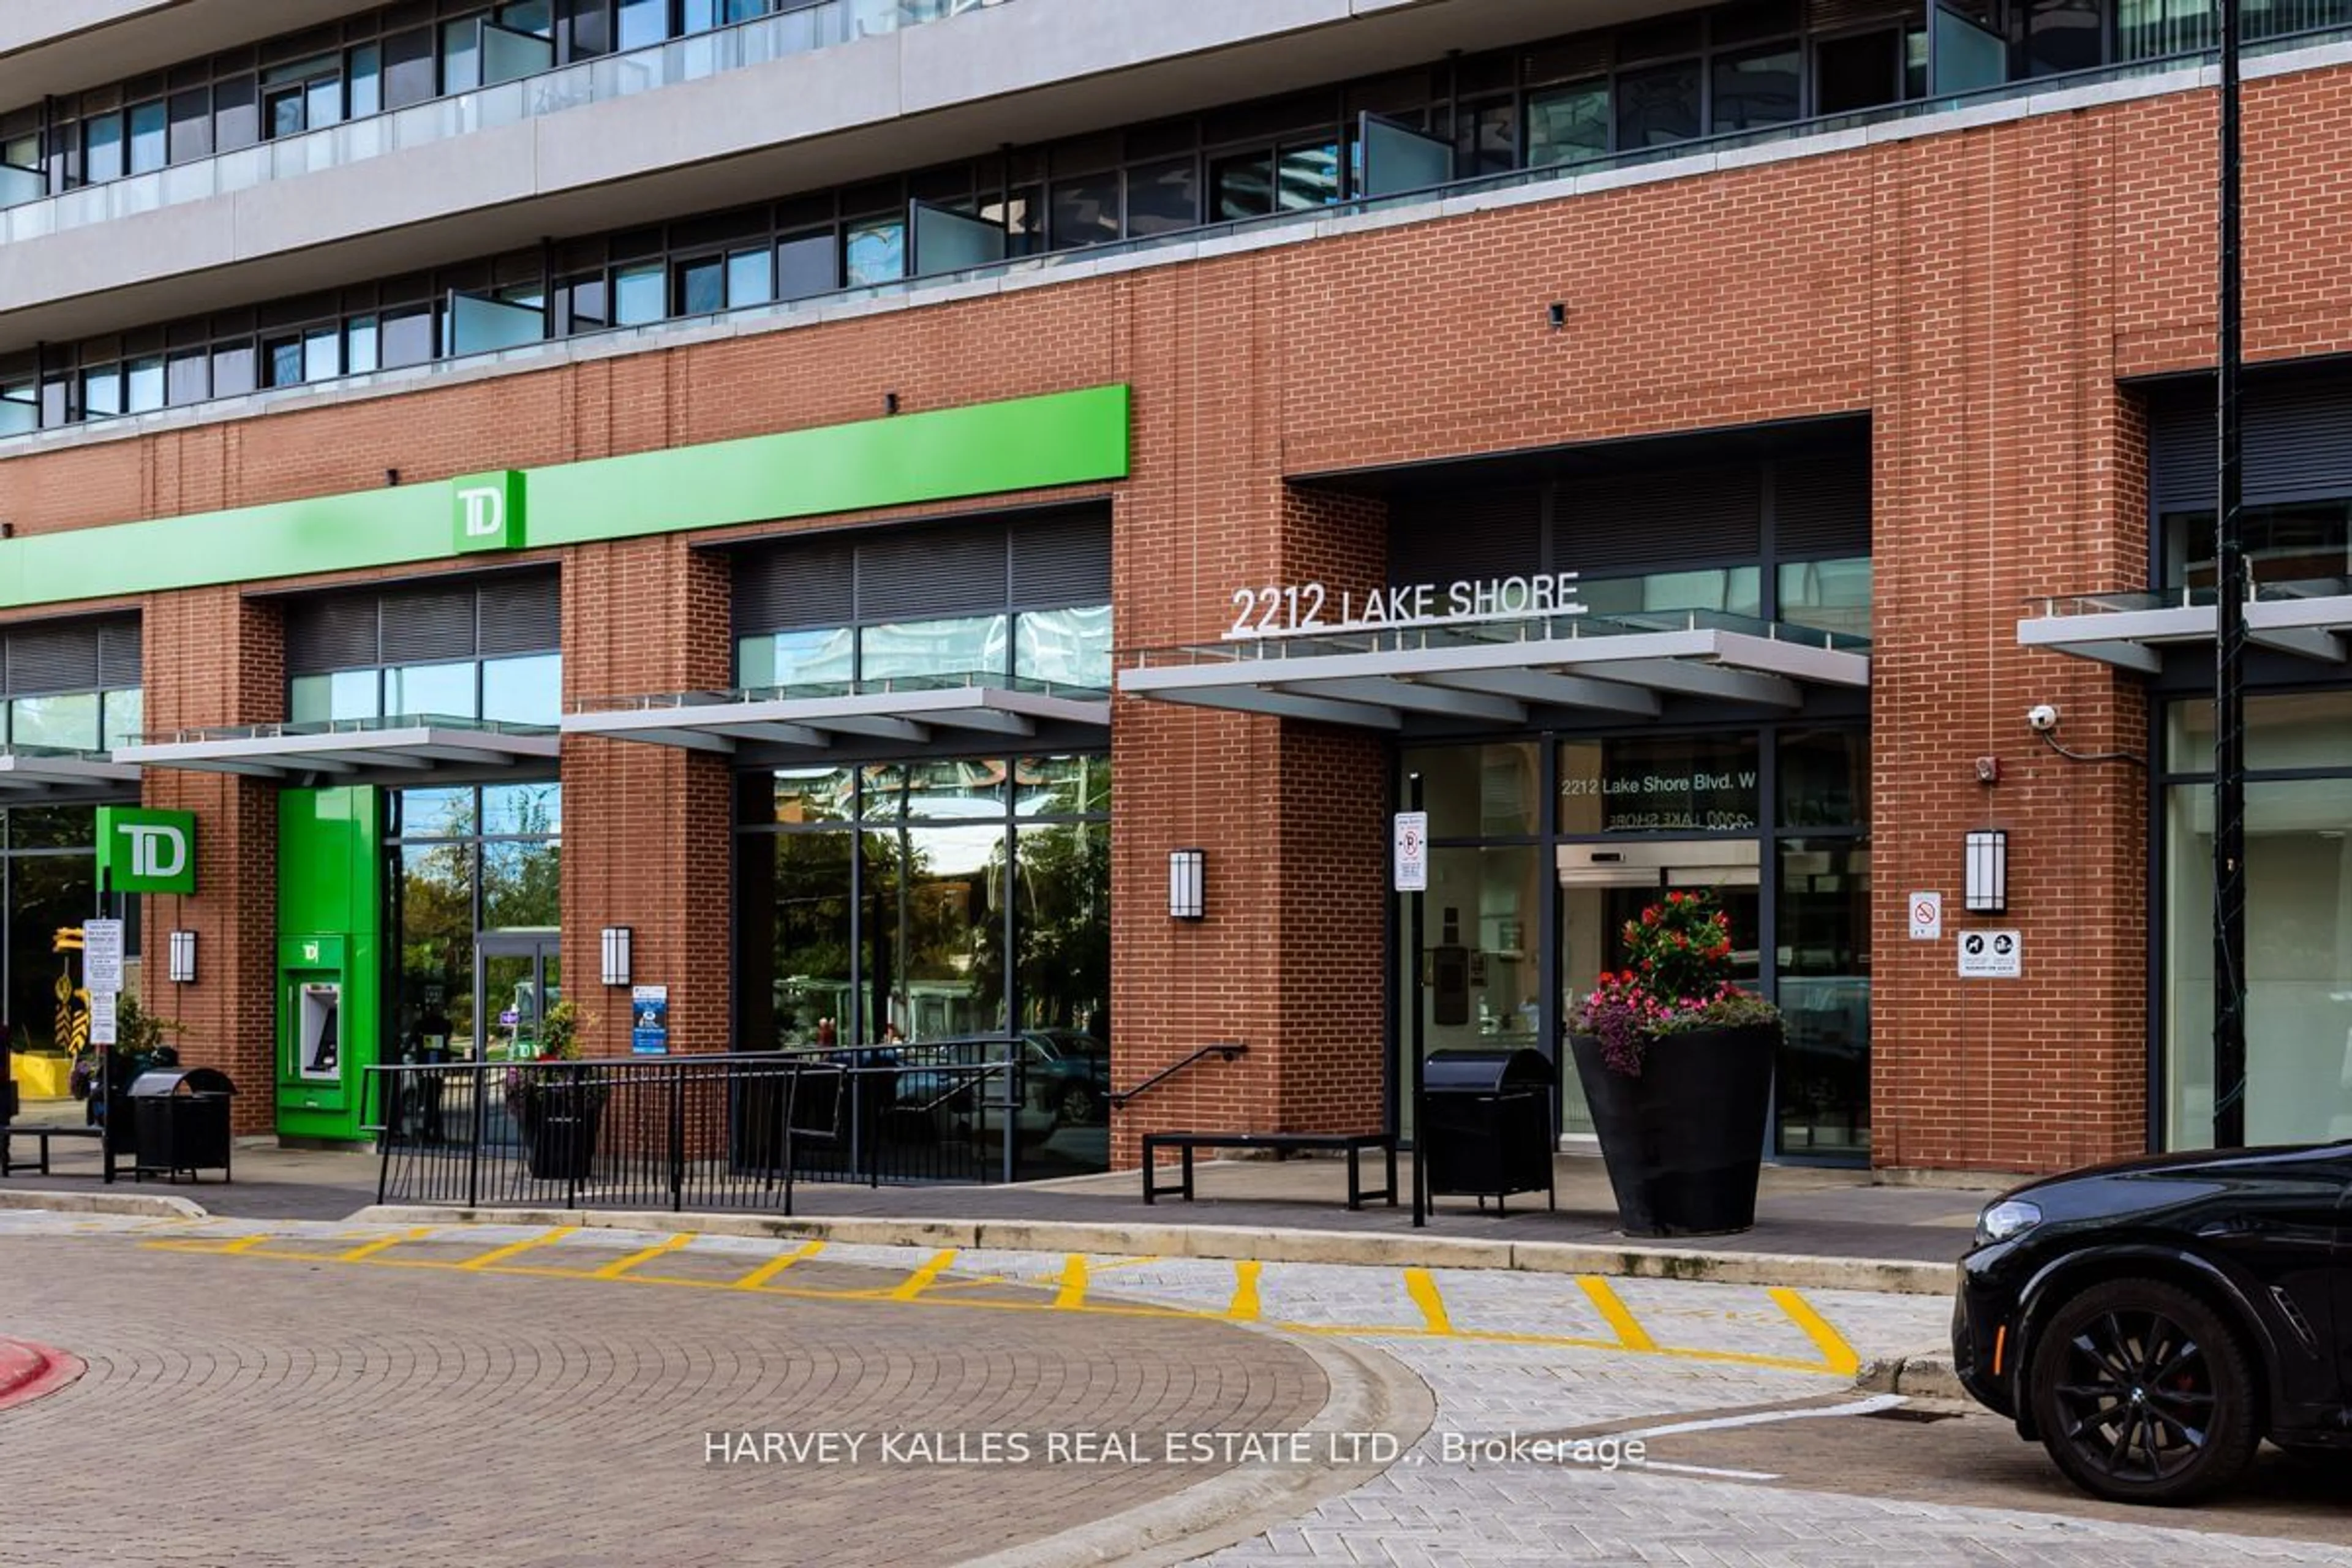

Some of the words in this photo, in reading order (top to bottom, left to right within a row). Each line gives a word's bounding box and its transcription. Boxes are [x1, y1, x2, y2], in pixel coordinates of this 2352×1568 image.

[458, 486, 502, 537] TD
[1232, 584, 1324, 635] 2212
[1343, 584, 1434, 625] LAKE
[1448, 572, 1578, 617] SHORE
[1562, 779, 1598, 795] 2212
[1603, 778, 1639, 793] Lake
[1644, 775, 1689, 793] Shore
[1694, 773, 1734, 790] Blvd.
[1738, 772, 1756, 788] W
[118, 824, 186, 876] TD
